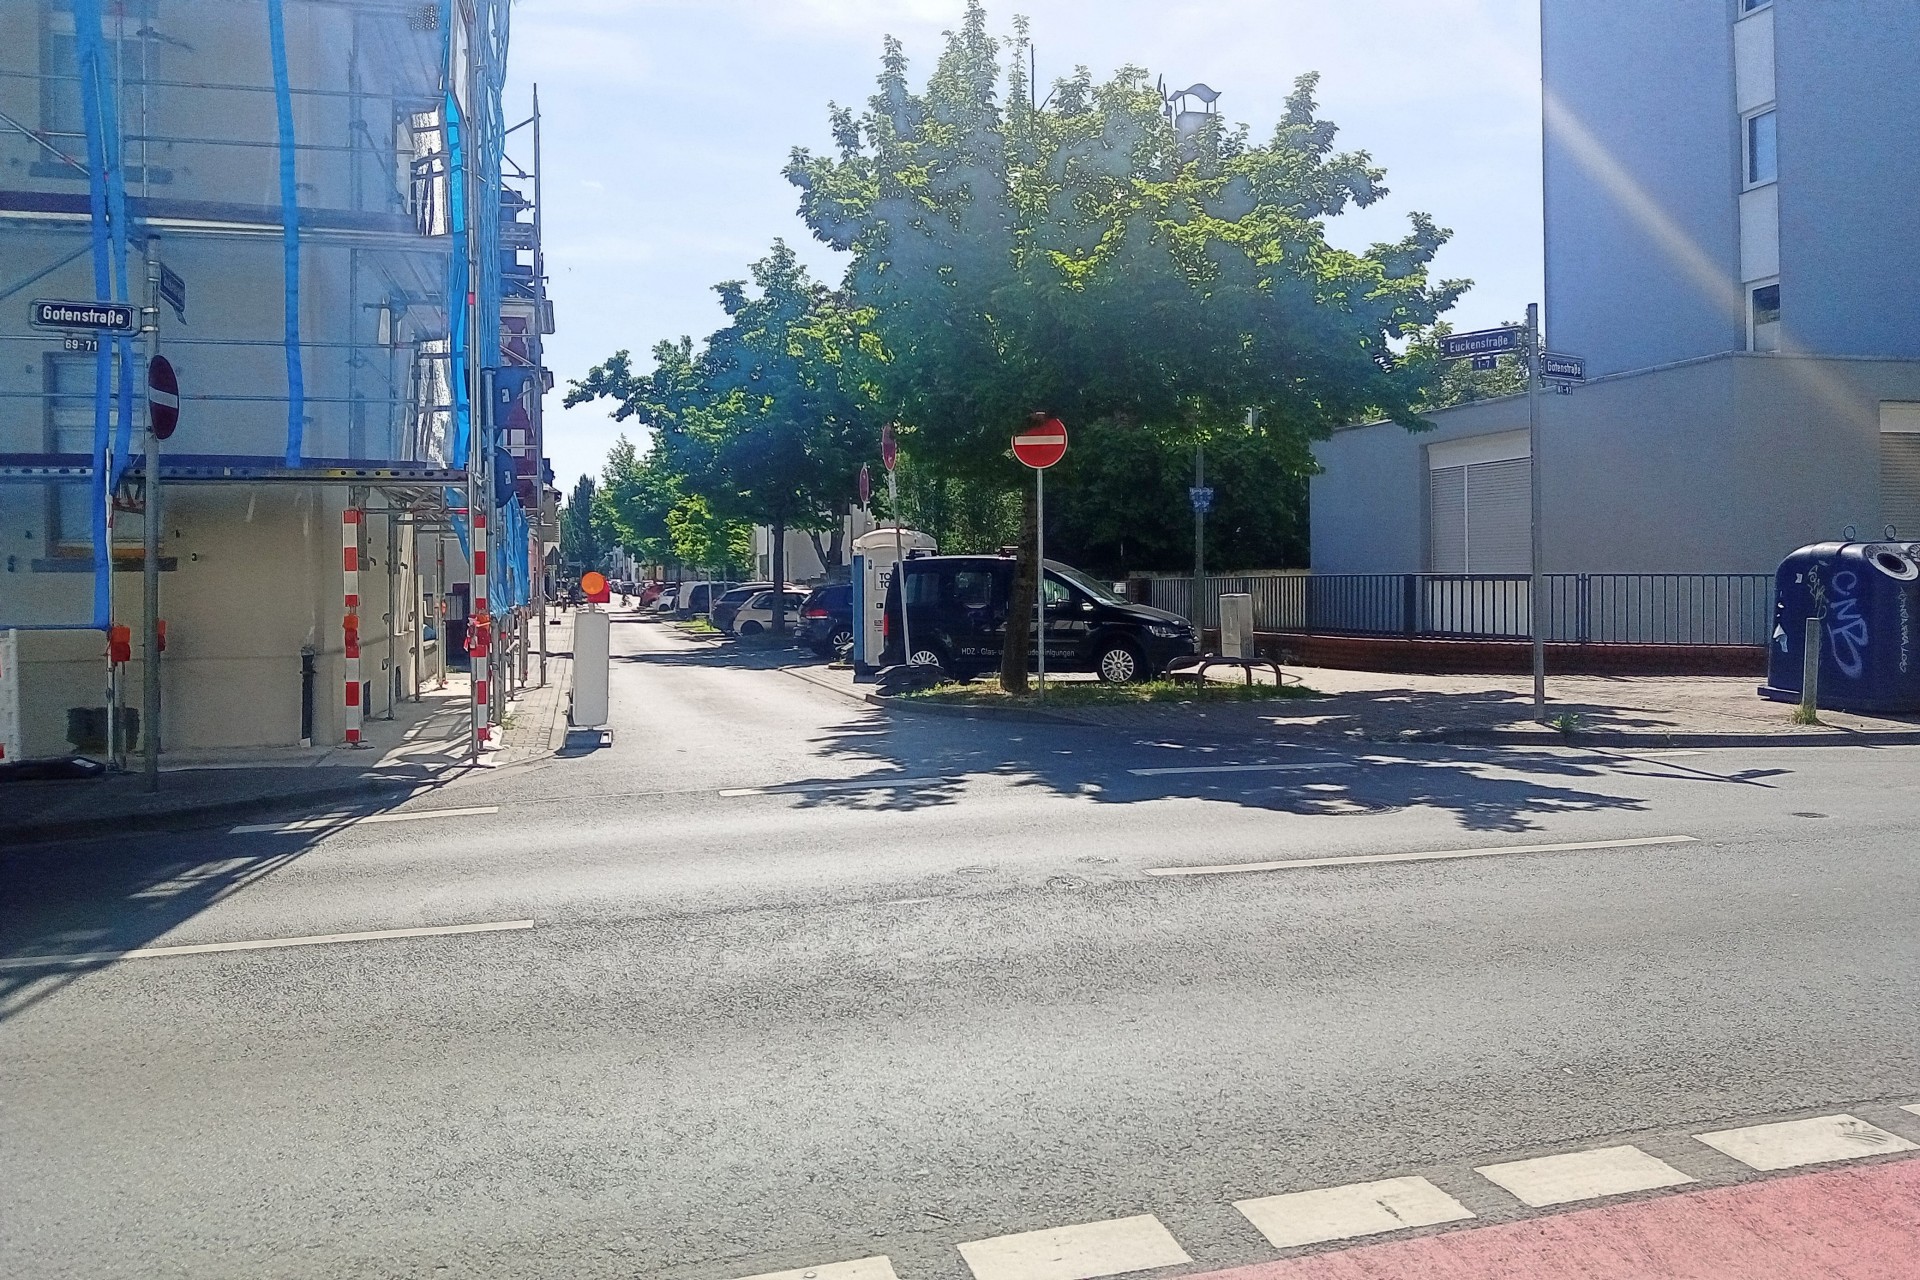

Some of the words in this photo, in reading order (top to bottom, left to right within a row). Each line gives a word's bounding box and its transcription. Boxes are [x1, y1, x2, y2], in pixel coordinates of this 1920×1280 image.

[43, 305, 124, 327] Gotenstraße
[65, 339, 98, 352] 69-71
[1449, 335, 1508, 353] Euckenstraße
[1477, 360, 1490, 369] 1-7
[1547, 360, 1581, 376] Gotenstraße
[879, 572, 892, 581] TO
[879, 581, 890, 589] TO
[961, 647, 976, 656] HDZ
